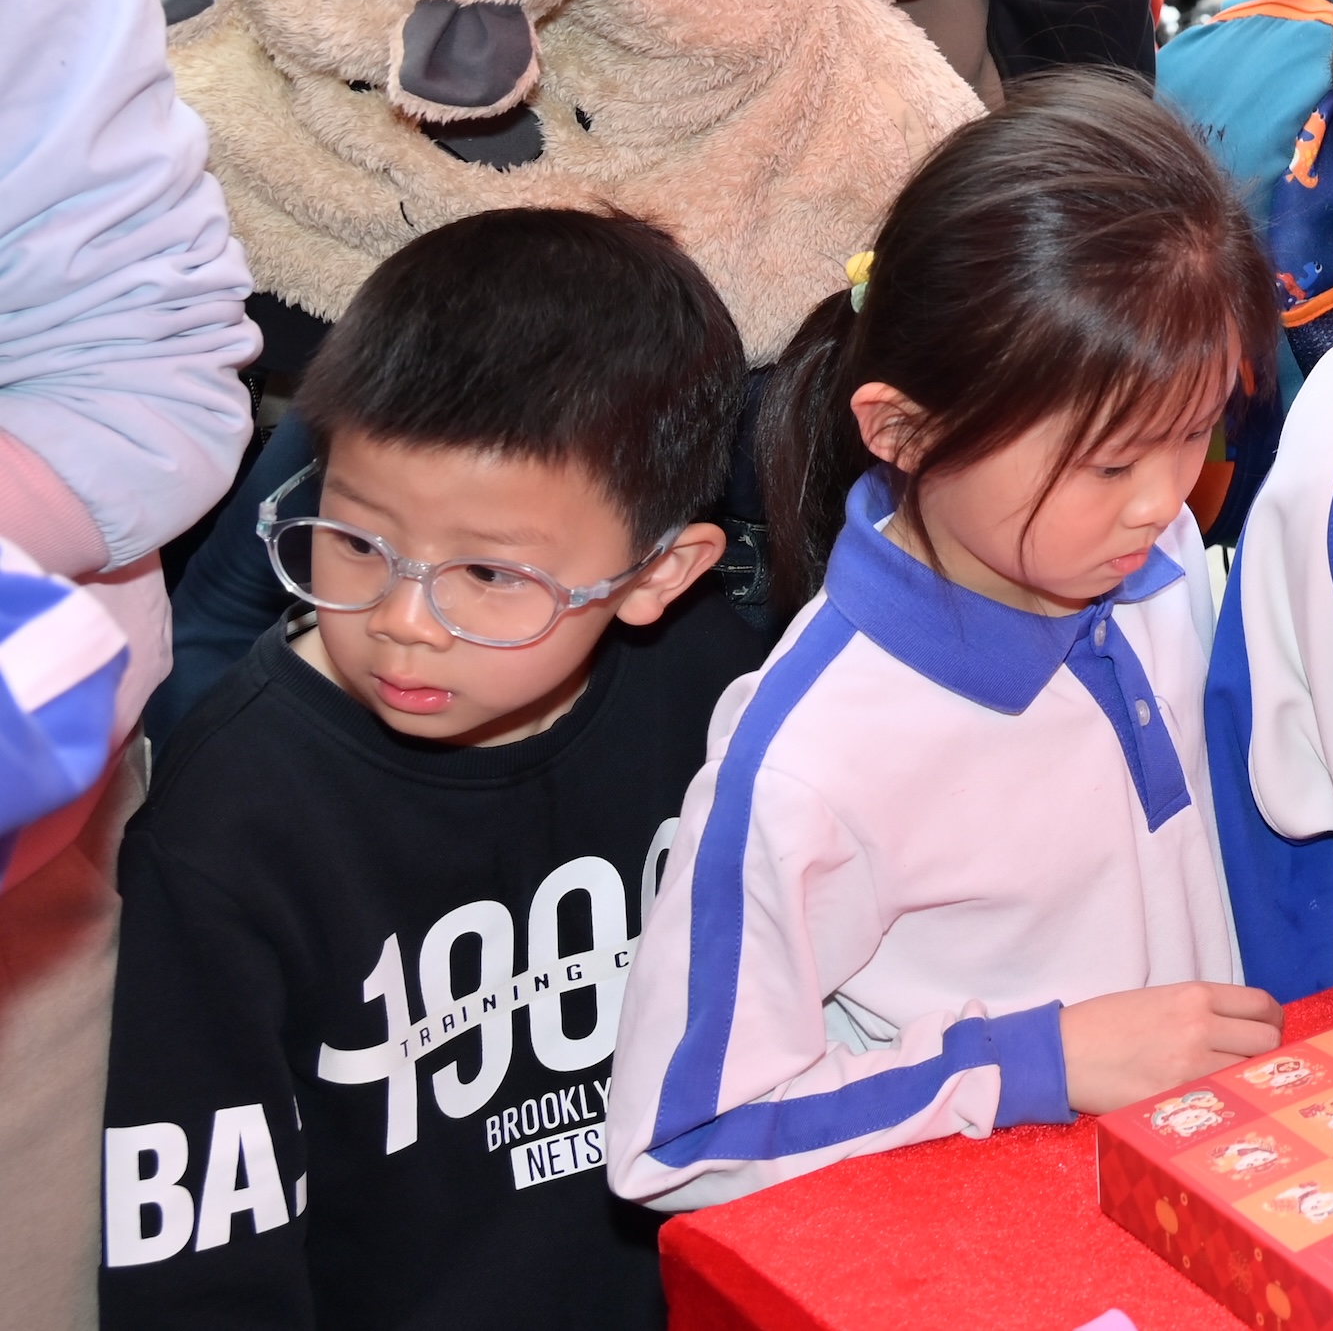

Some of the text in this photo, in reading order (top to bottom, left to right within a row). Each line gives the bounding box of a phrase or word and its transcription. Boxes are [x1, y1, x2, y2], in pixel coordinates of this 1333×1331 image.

[400, 963, 583, 1059] TRAINING
[485, 1076, 613, 1154] BROOKLY
[525, 1128, 603, 1182] NETS
[105, 1094, 308, 1268] BA
